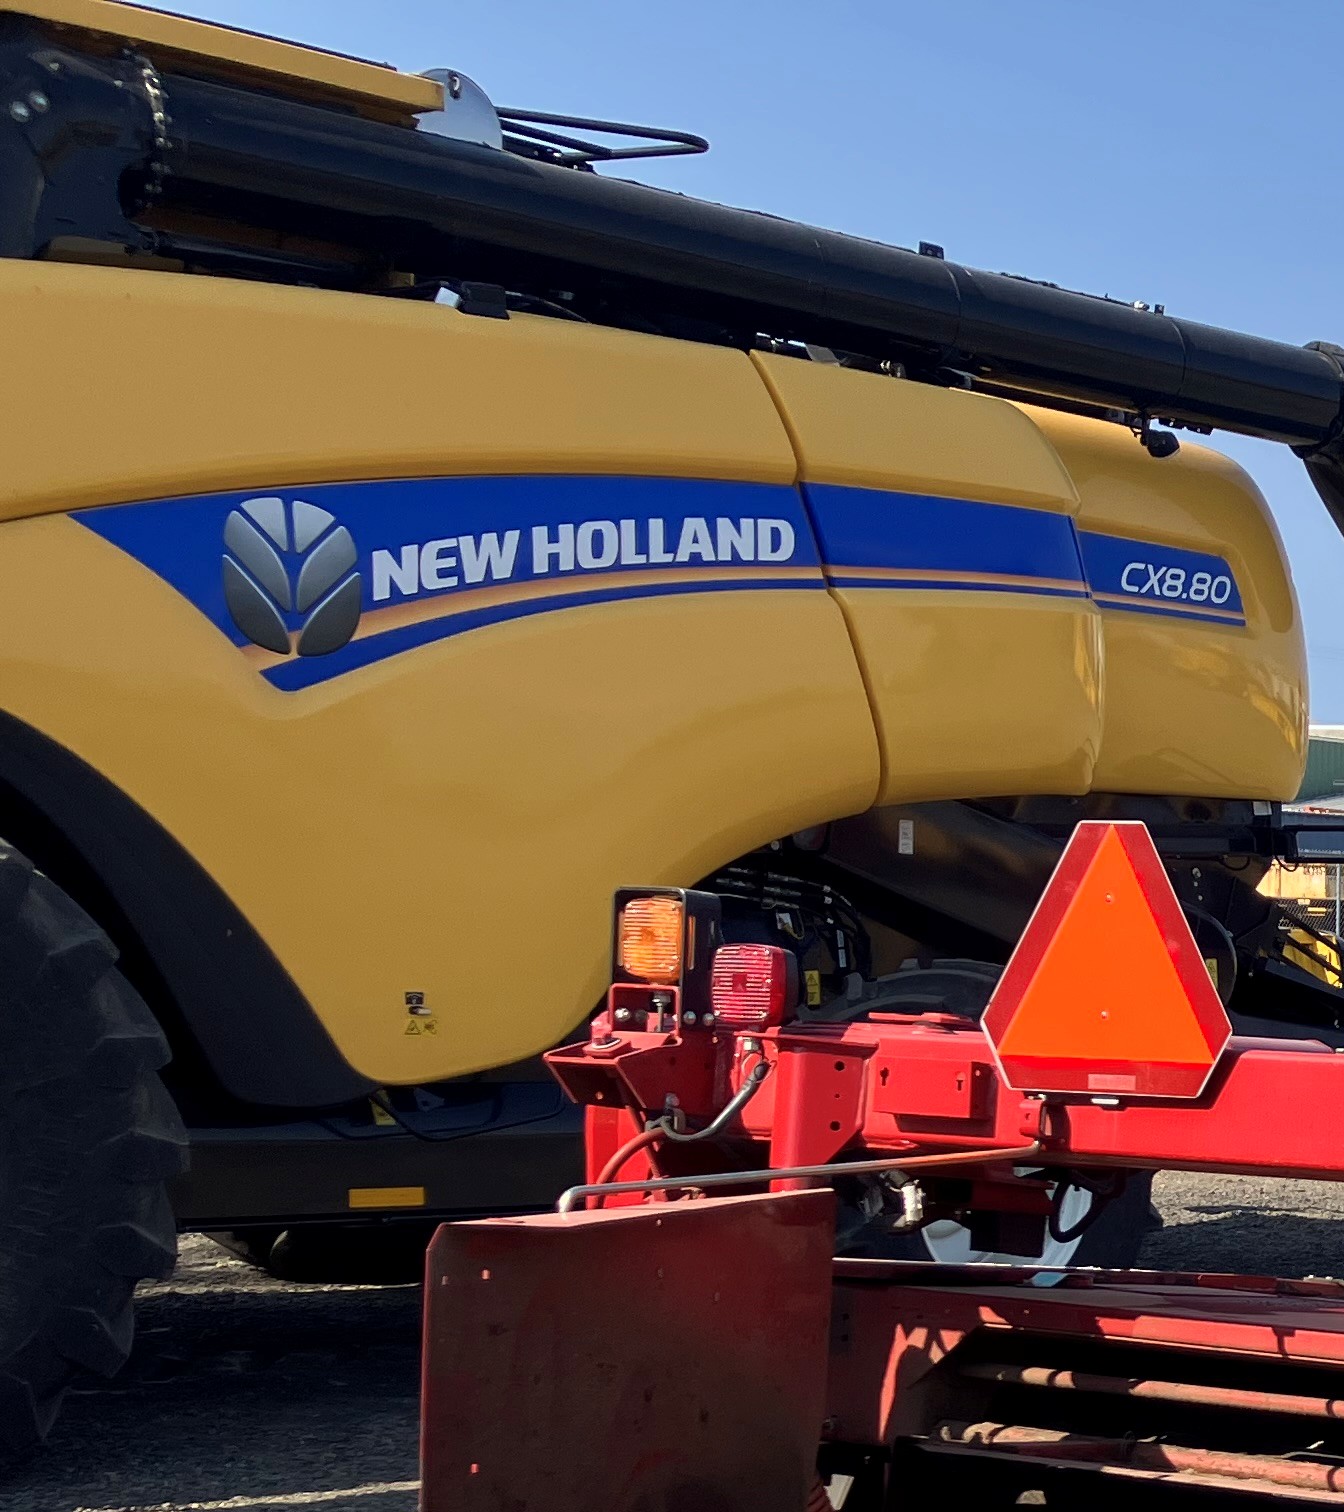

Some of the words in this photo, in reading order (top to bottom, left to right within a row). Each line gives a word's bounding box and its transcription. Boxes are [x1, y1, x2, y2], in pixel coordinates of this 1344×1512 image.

[372, 529, 520, 601] NEW
[532, 517, 795, 574] HOLLAND
[1120, 562, 1231, 604] CX8.80
